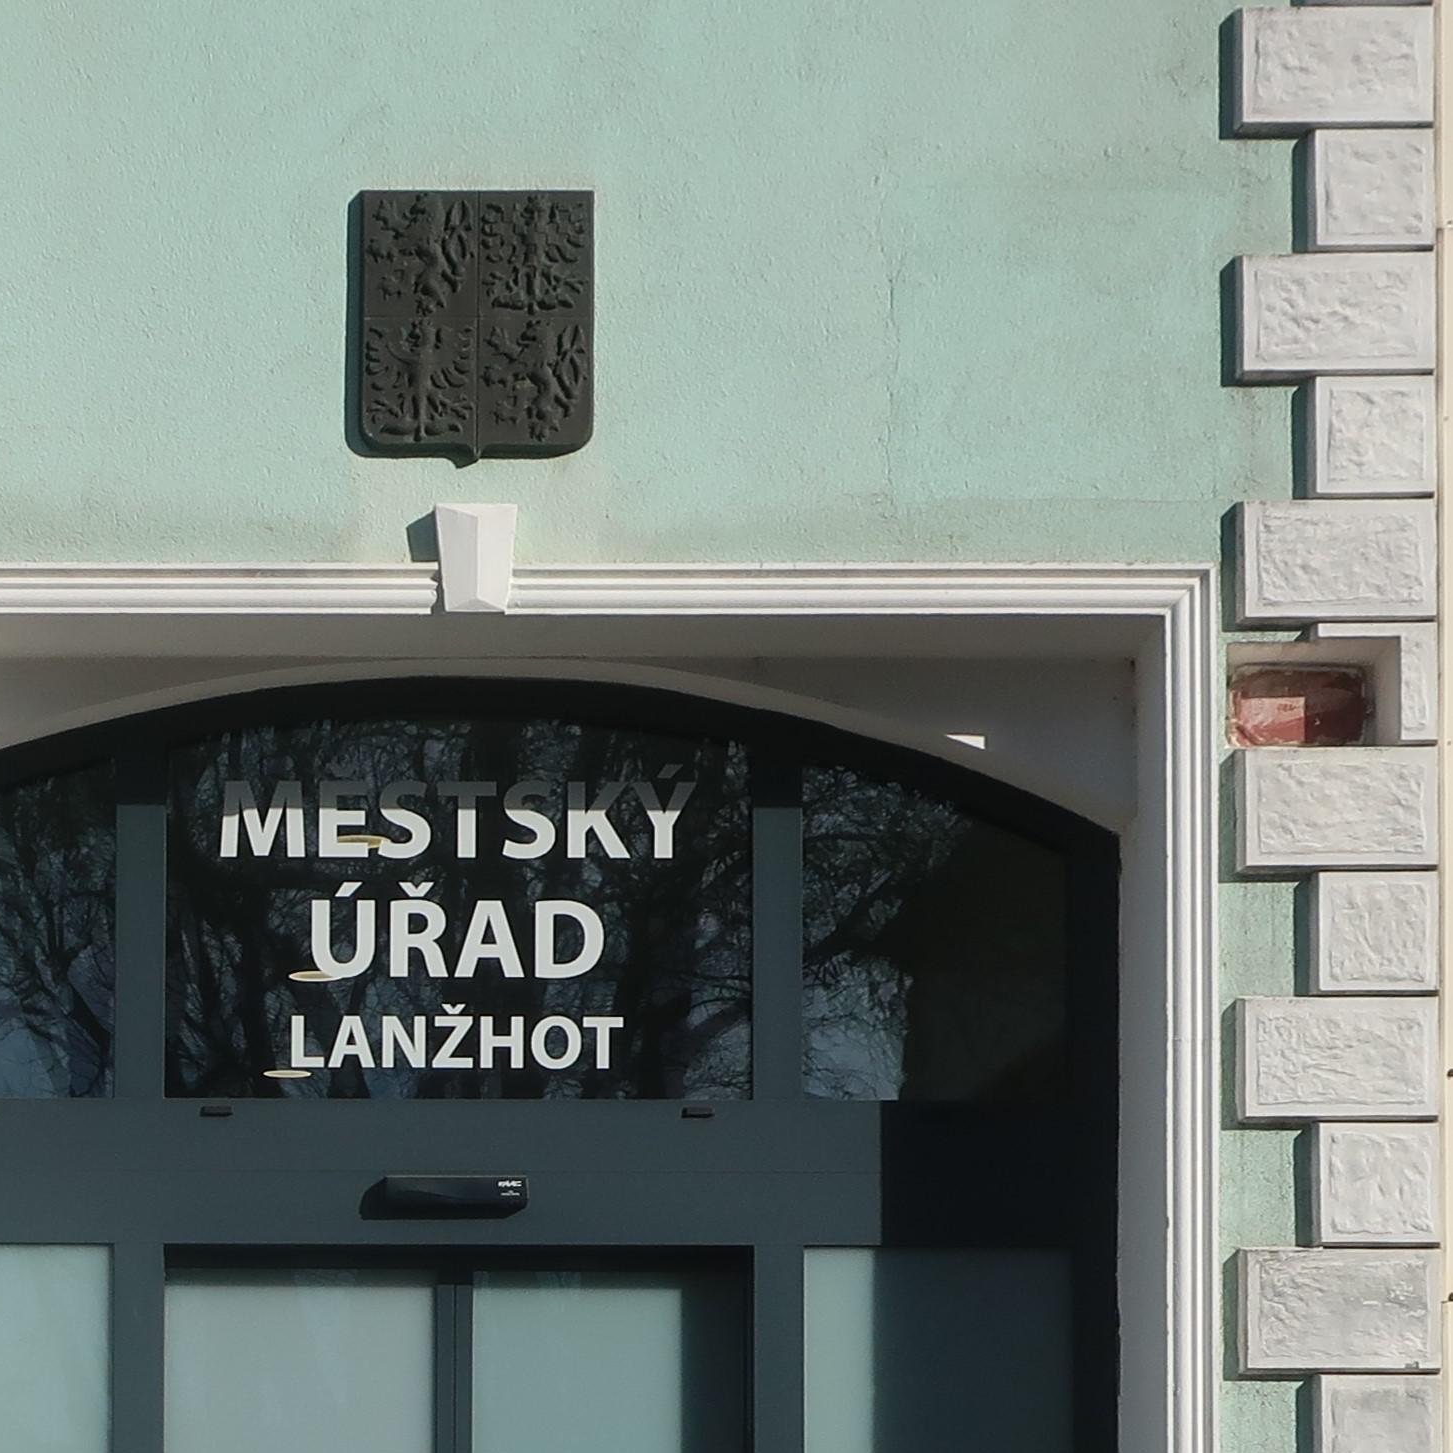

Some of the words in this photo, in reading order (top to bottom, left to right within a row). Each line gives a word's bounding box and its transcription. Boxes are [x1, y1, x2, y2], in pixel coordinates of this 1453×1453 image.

[219, 760, 697, 859] MĚSTSKÝ
[310, 881, 605, 979] ÚŘAD
[290, 1002, 624, 1070] LANŽHOT
